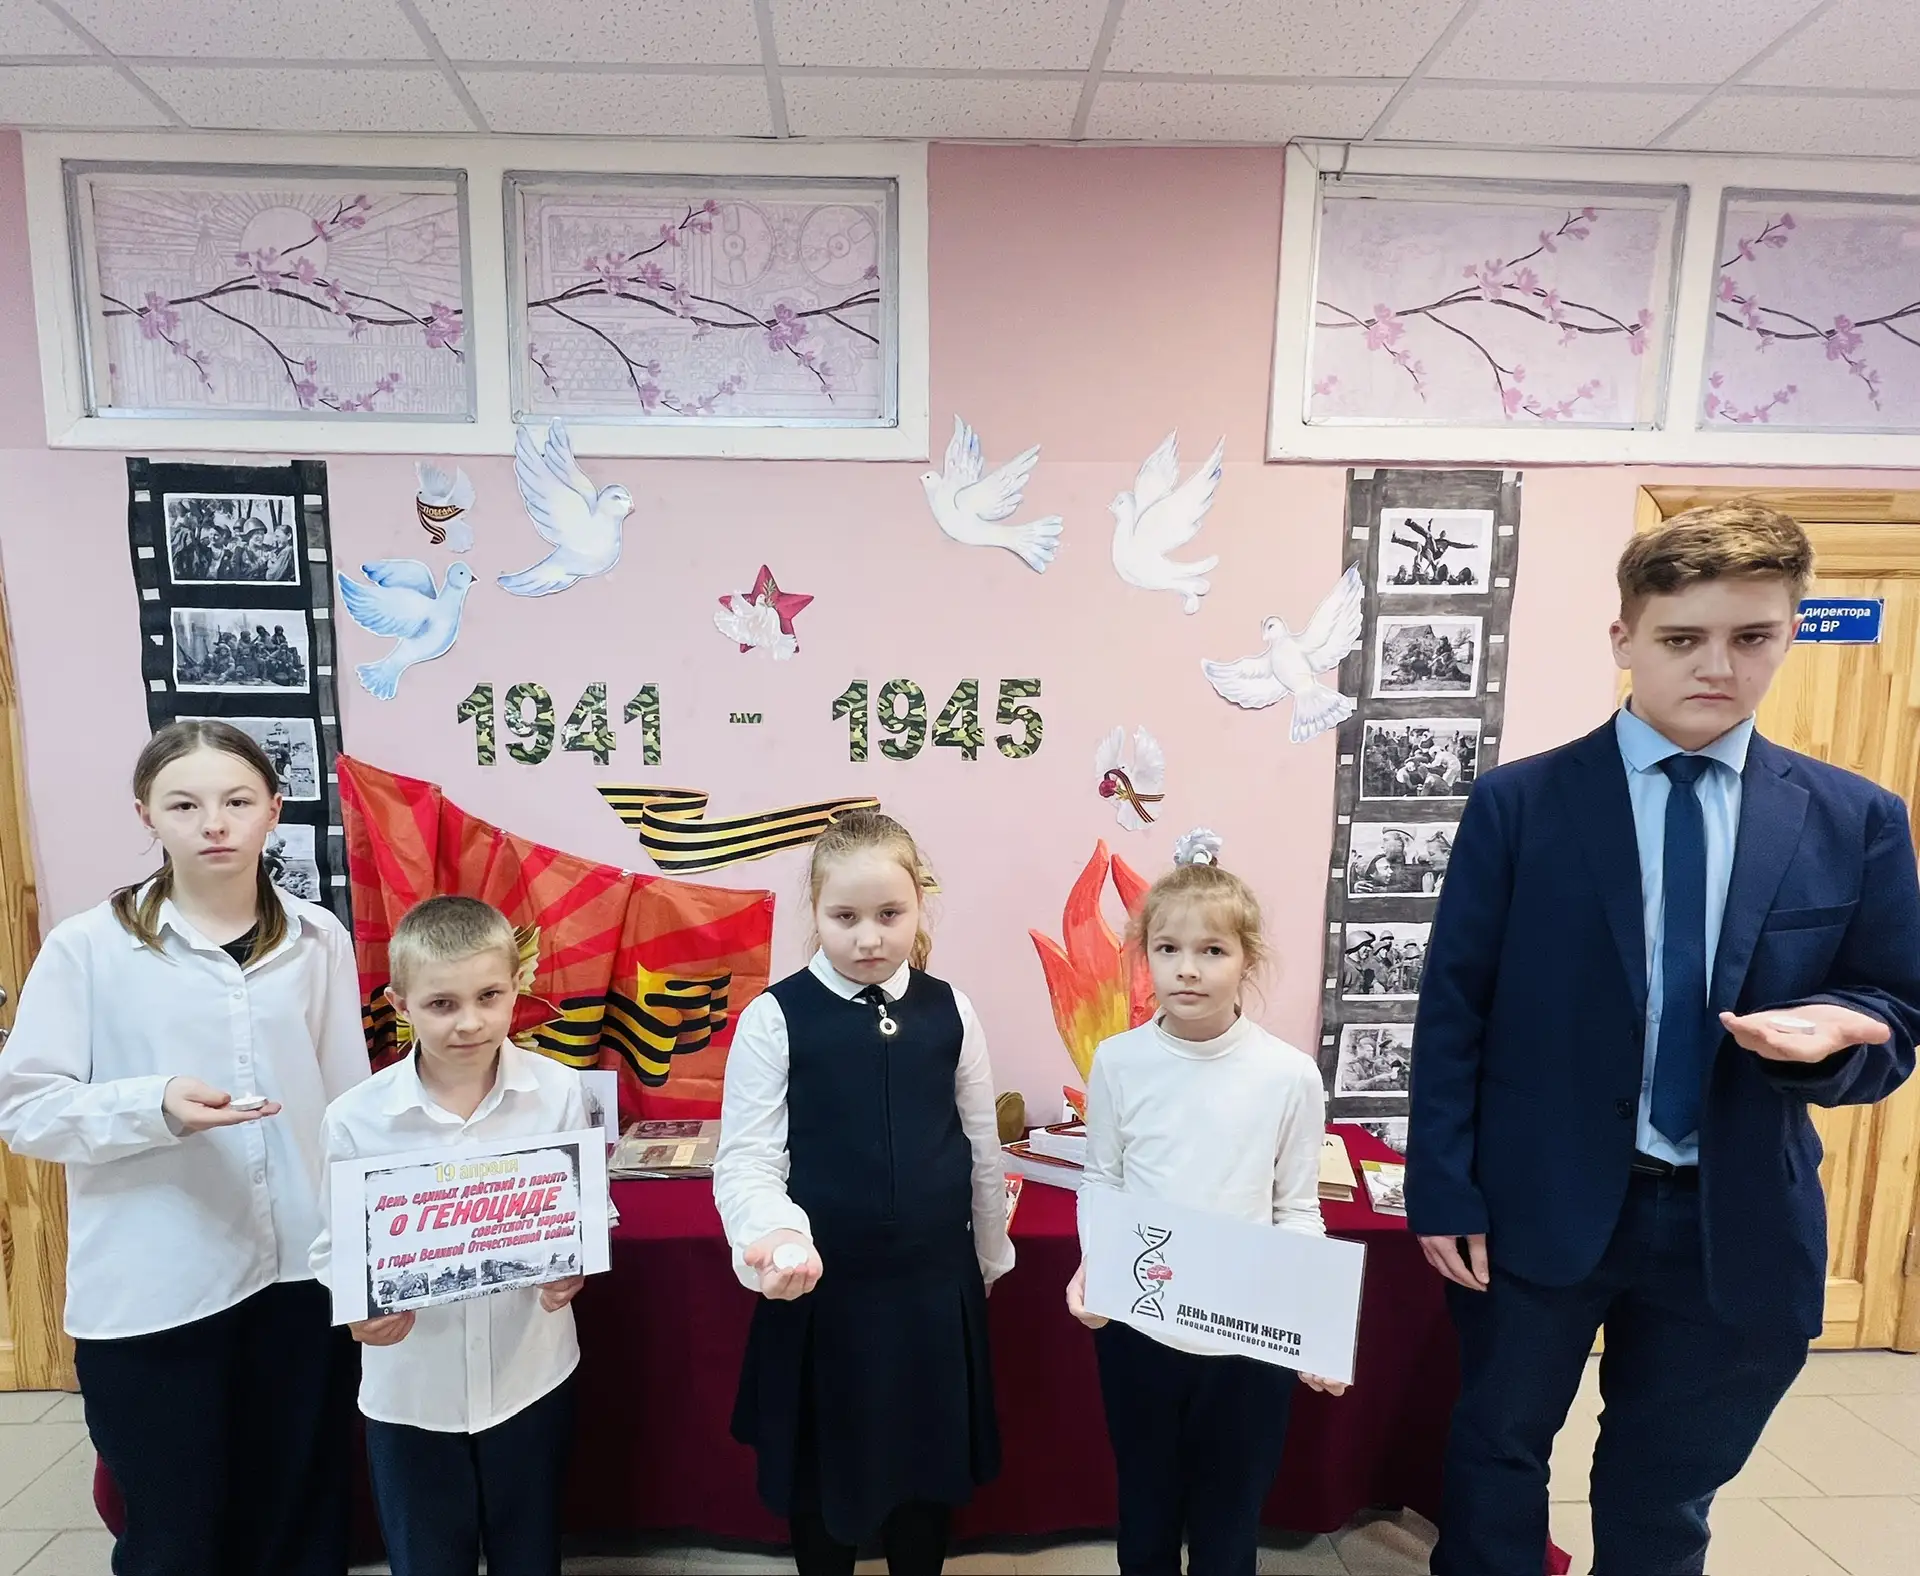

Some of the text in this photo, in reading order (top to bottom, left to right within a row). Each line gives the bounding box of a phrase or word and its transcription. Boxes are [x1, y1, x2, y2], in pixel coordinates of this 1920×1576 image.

[1800, 620, 1840, 632] по ВР
[1804, 607, 1871, 619] директора
[457, 682, 663, 766] 1941
[832, 678, 1044, 762] 1945
[435, 1158, 519, 1183] 19 апреля
[375, 1195, 408, 1212] День
[412, 1187, 459, 1205] единых
[460, 1177, 515, 1200] действий
[529, 1171, 568, 1187] память
[416, 1185, 562, 1232] ГЕНОЦИДЕ
[471, 1211, 576, 1238] советского народа
[387, 1252, 417, 1269] годы
[419, 1242, 465, 1262] Великой
[467, 1230, 542, 1254] Отечественной
[544, 1225, 576, 1241] войны
[1176, 1317, 1301, 1357] ГЕНОЦИДА СОВЕТСКОГО НАРОДА
[1177, 1303, 1302, 1346] ДЕНЬ ПАМЯТИ ЖЕРТВ
